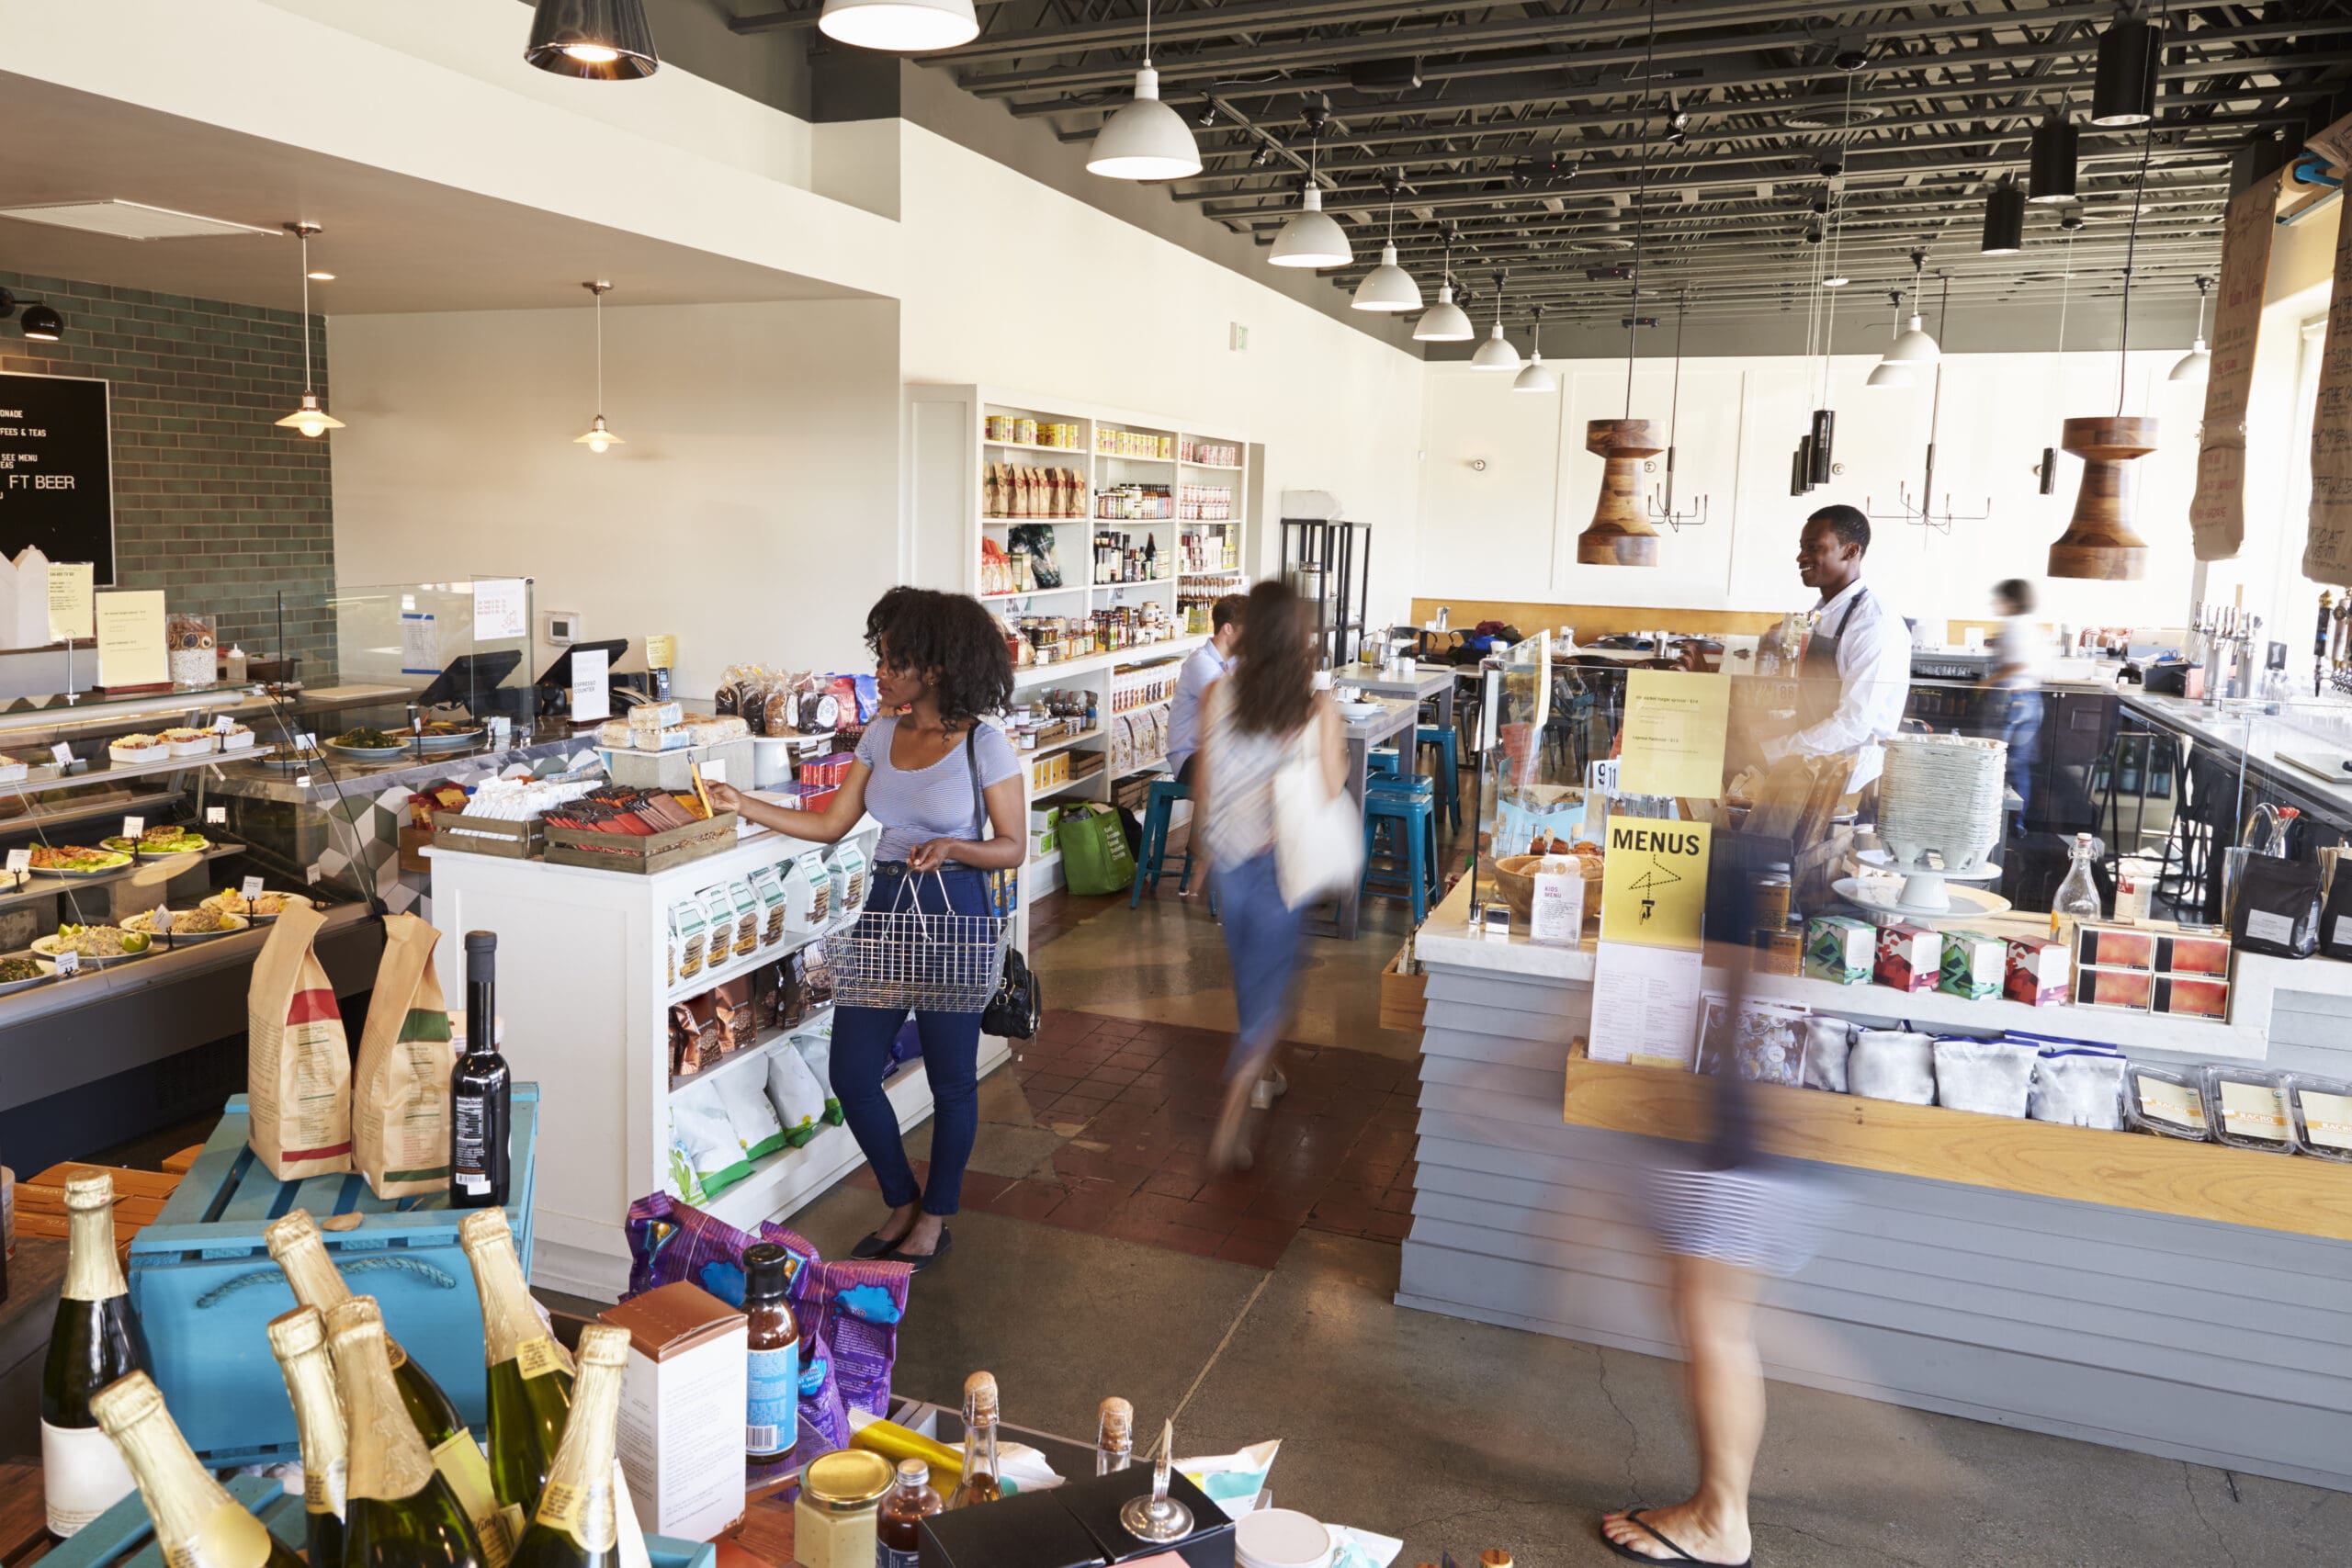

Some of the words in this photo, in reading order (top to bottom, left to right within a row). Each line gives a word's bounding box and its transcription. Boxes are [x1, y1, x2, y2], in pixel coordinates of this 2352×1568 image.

[18, 454, 38, 462] MENU
[9, 475, 30, 489] FT
[35, 475, 75, 490] BEER
[1612, 828, 1700, 856] MENUS
